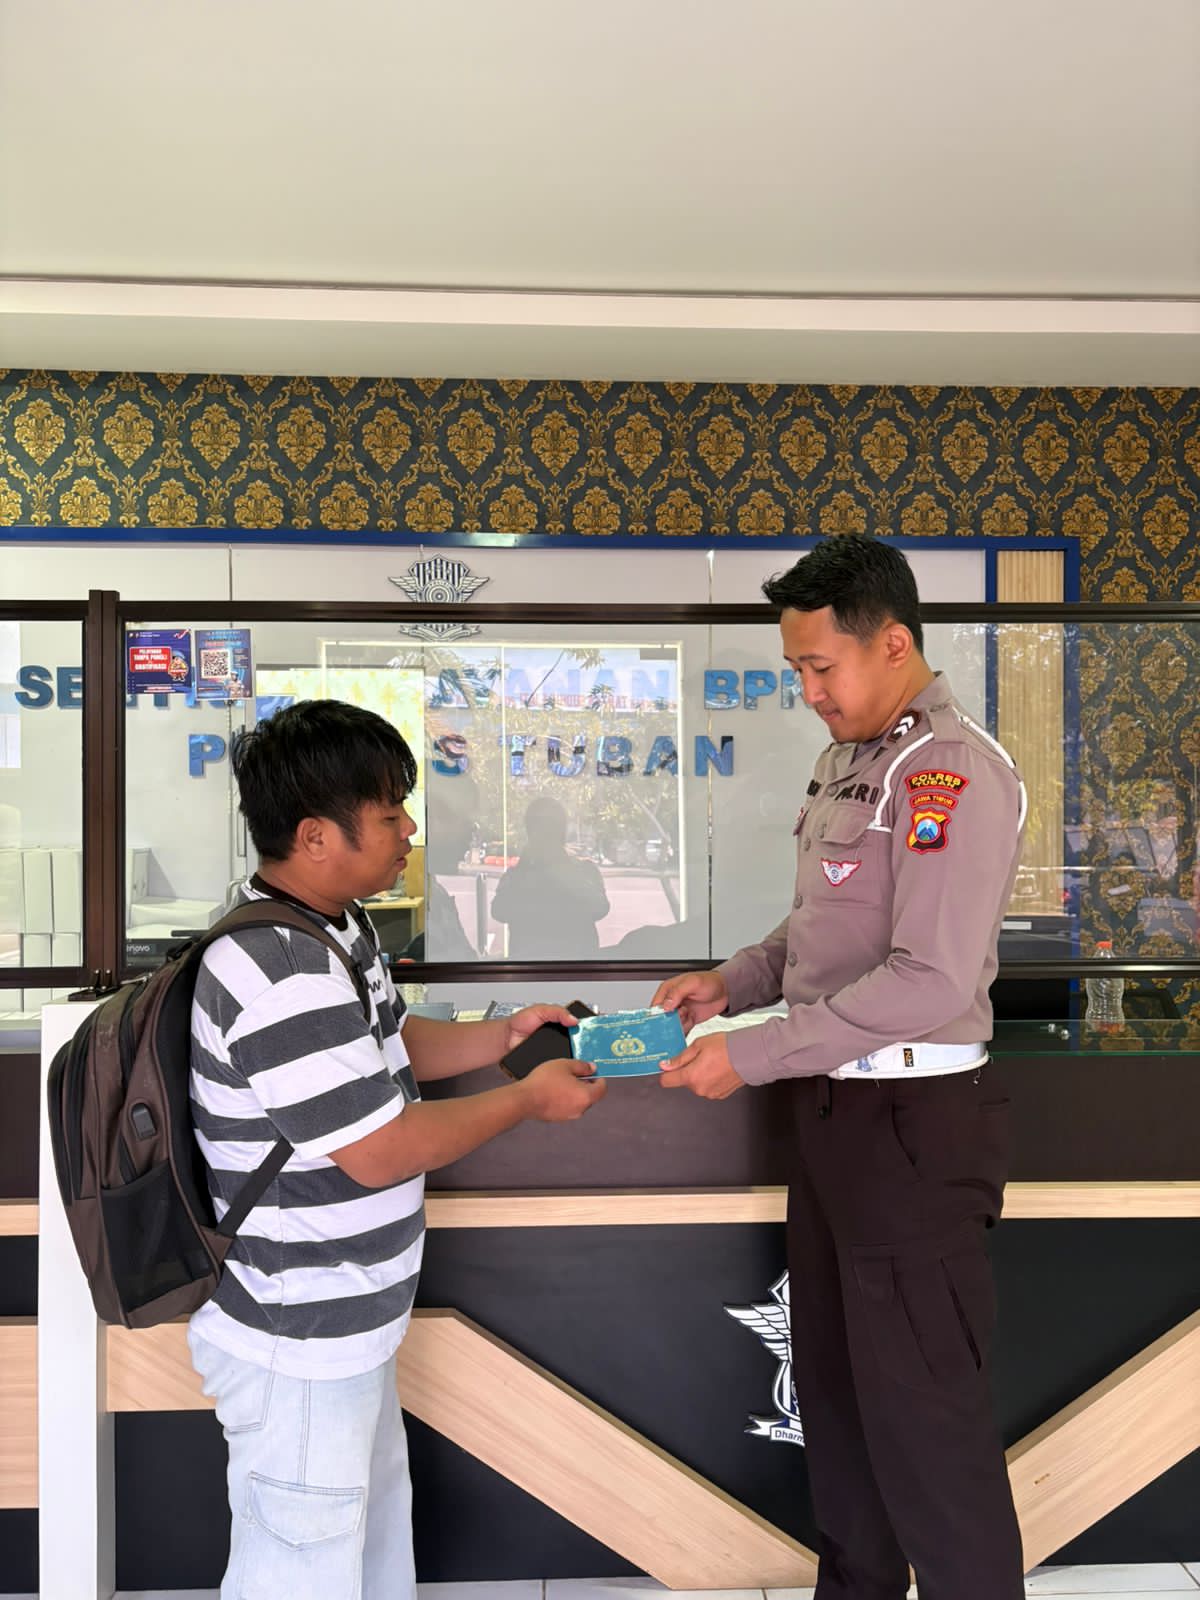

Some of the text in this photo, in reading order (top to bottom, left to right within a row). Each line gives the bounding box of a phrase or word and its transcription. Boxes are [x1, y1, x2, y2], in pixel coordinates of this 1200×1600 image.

[498, 735, 734, 777] TUBAN
[911, 773, 961, 786] POLRES
[915, 780, 956, 788] TUBAN
[774, 1430, 803, 1442] Dharm
